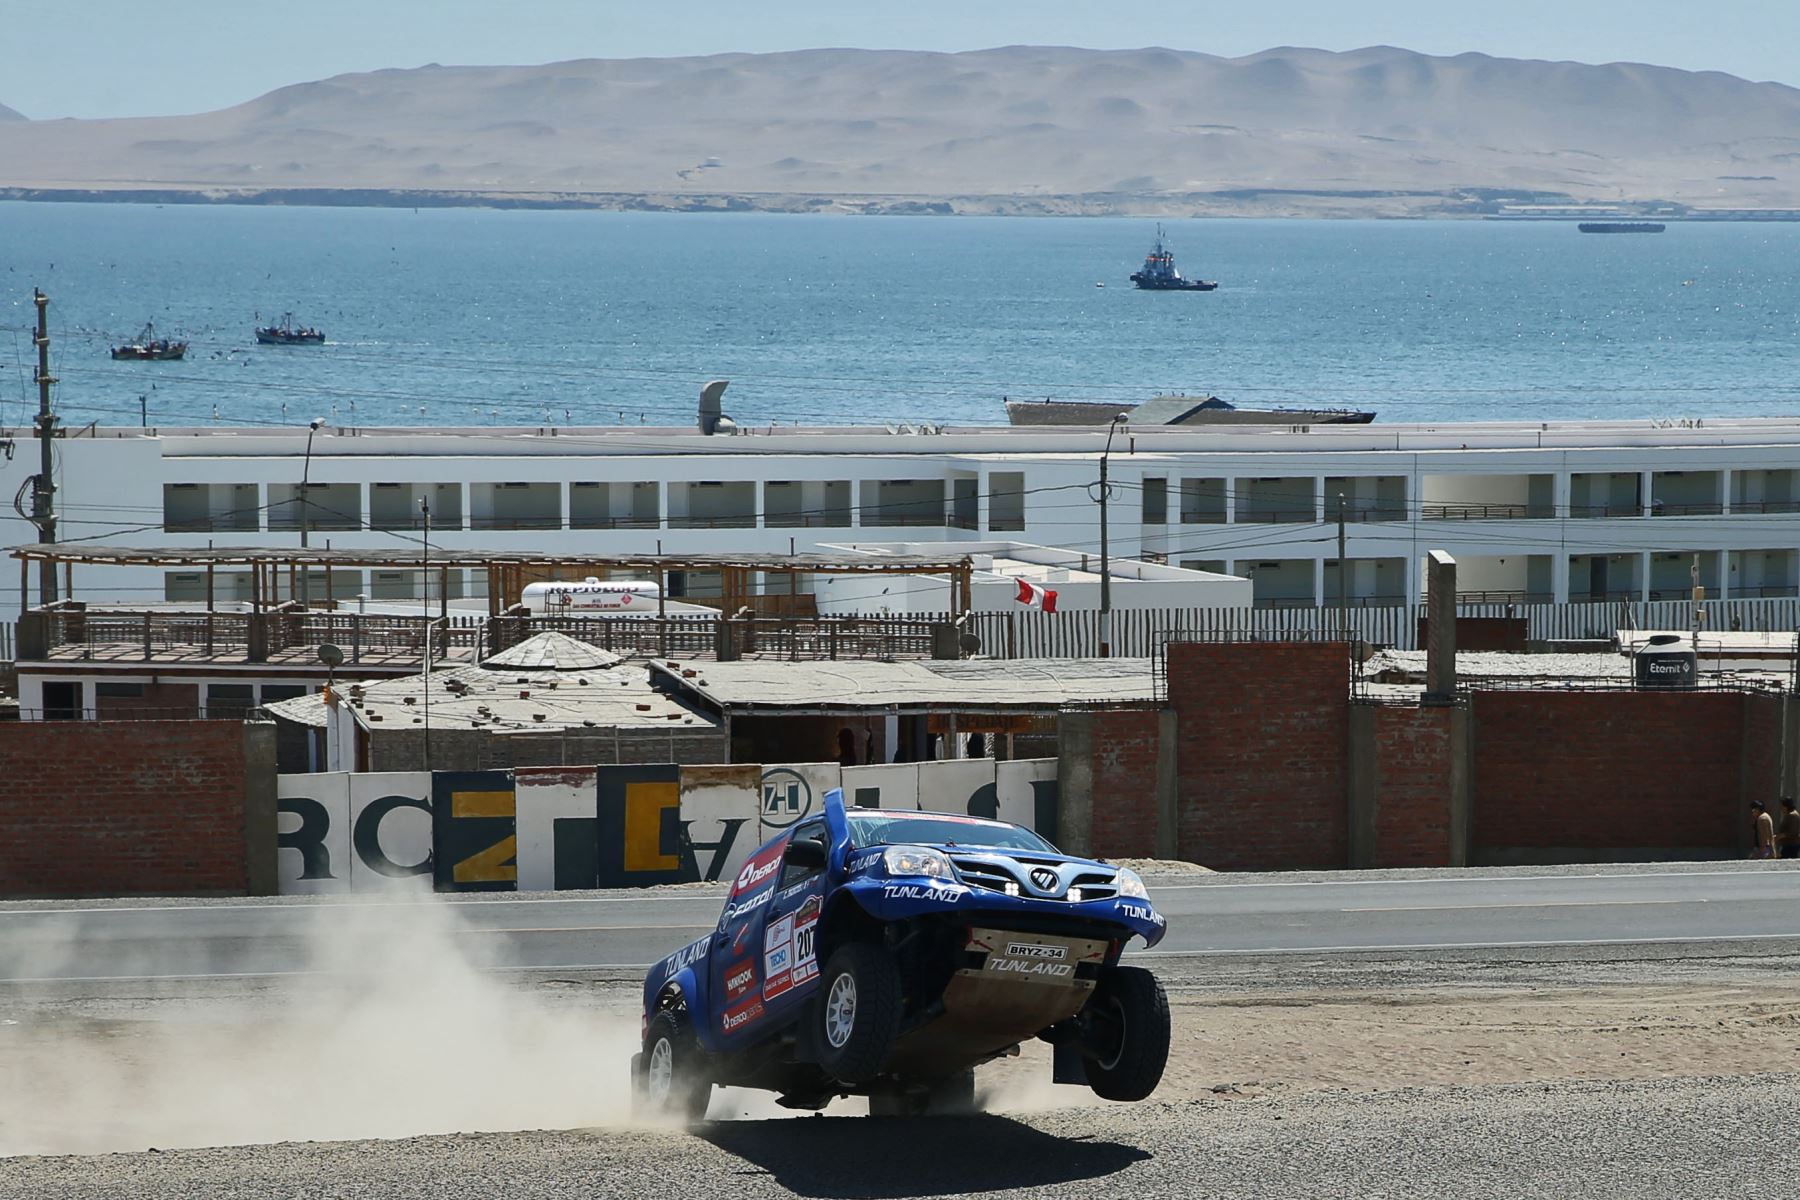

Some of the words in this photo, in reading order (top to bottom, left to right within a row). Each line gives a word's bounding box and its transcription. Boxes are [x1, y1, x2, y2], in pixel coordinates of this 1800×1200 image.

[1650, 663, 1681, 673] Eternit
[749, 855, 782, 884] DERCO
[731, 885, 775, 919] FOTON
[884, 885, 962, 904] TUNLAND
[1122, 904, 1166, 928] TUNLAND
[664, 936, 711, 978] TUNLAND
[991, 958, 1072, 977] TUNLAND
